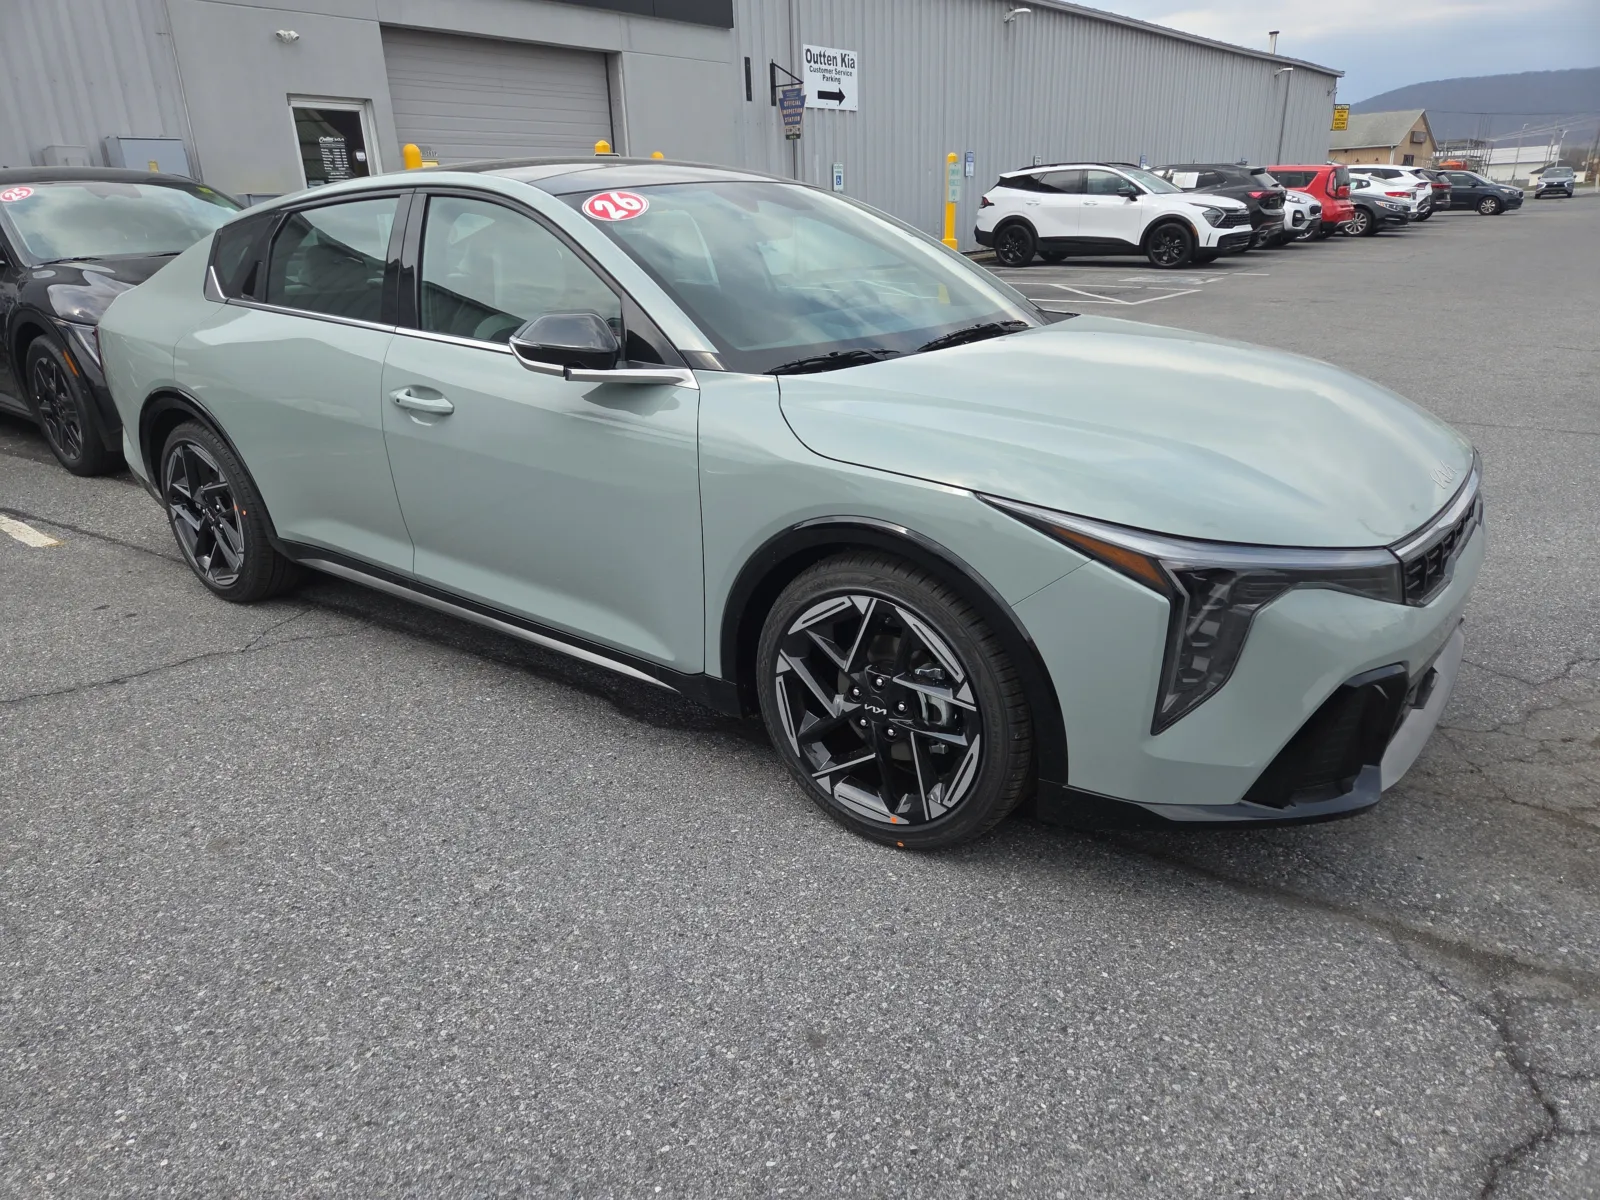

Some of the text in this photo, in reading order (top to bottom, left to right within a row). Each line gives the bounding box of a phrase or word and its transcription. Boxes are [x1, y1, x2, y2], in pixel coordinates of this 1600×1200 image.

[805, 48, 855, 69] Outten Kia
[809, 65, 852, 77] Customer Service
[822, 74, 841, 84] Parking
[4, 187, 28, 201] 25
[594, 192, 642, 220] 26
